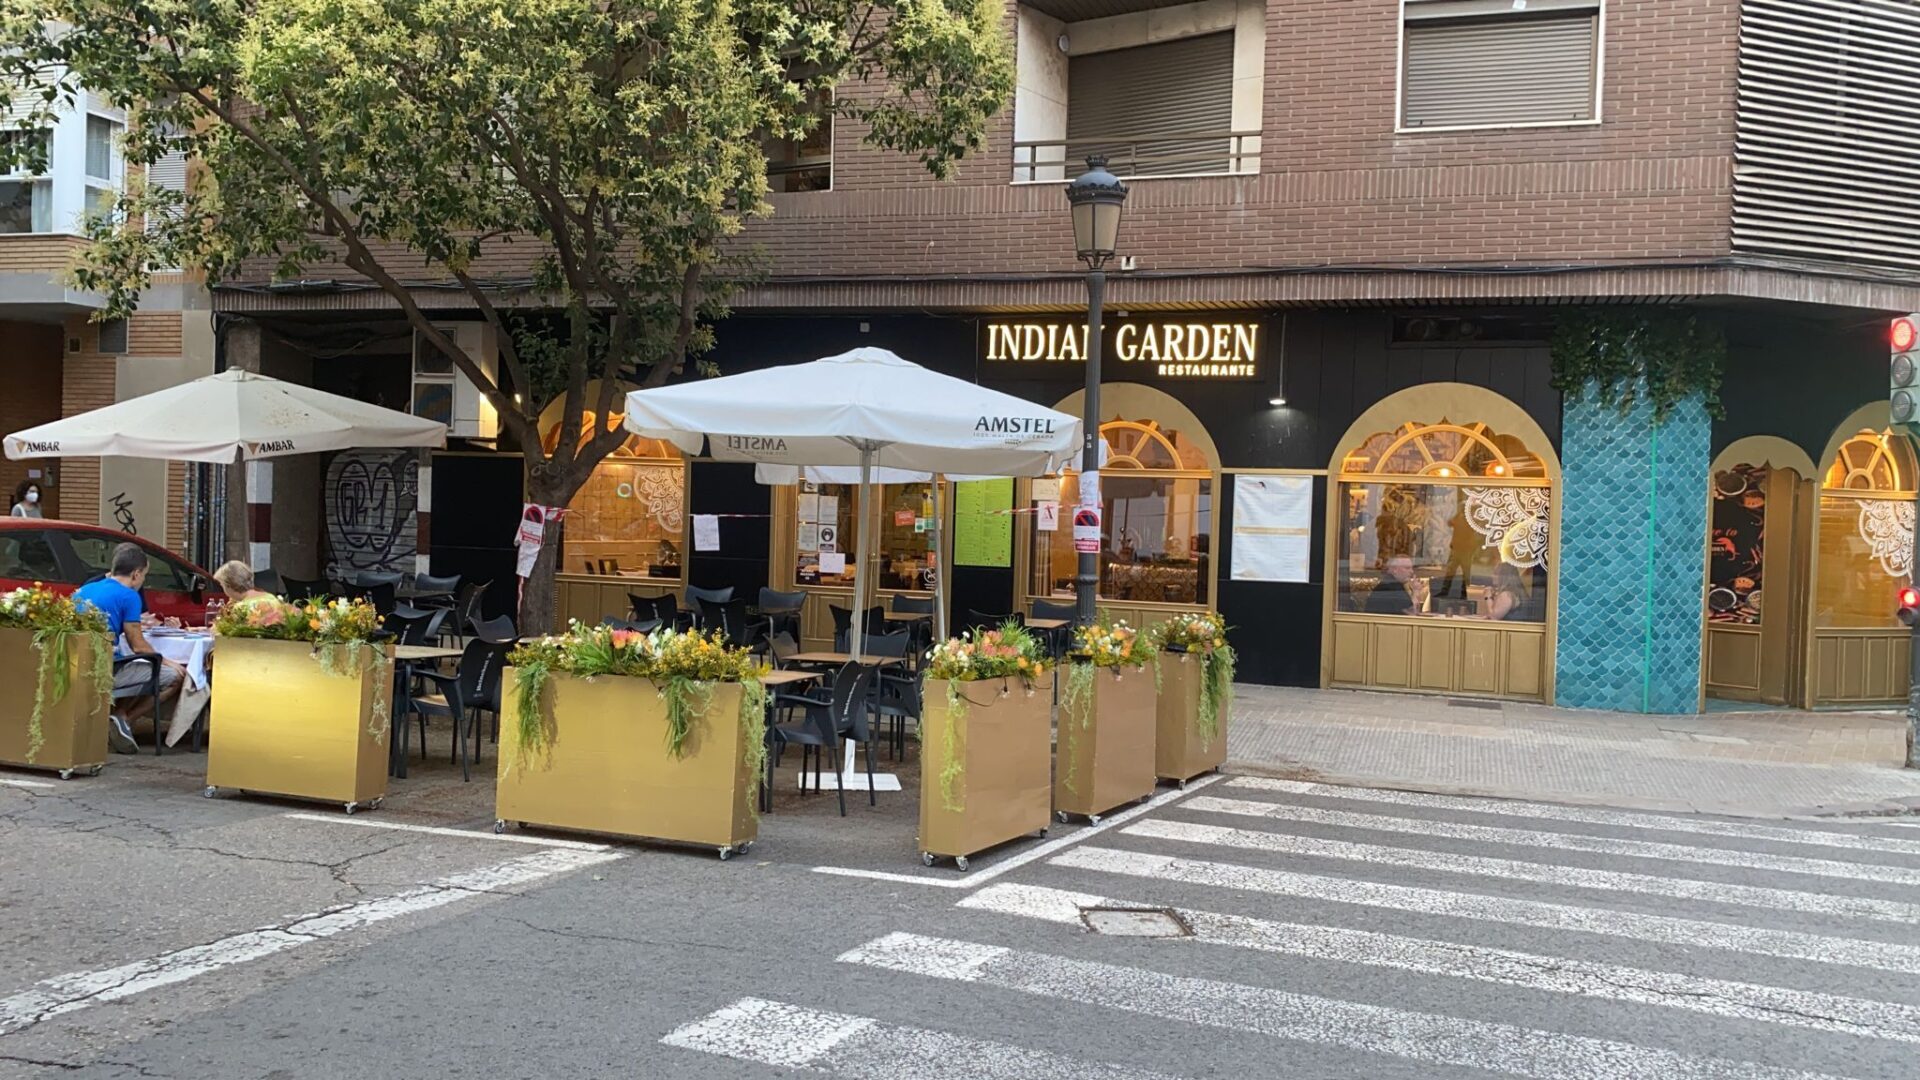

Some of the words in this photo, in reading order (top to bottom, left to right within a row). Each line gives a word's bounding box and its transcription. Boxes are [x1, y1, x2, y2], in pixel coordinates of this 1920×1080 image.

[1115, 324, 1259, 362] GARDEN
[1158, 364, 1256, 376] RESTAURANTE
[975, 416, 1056, 434] AMSTEL
[26, 441, 60, 453] AMBAR
[259, 439, 295, 454] AMBAR
